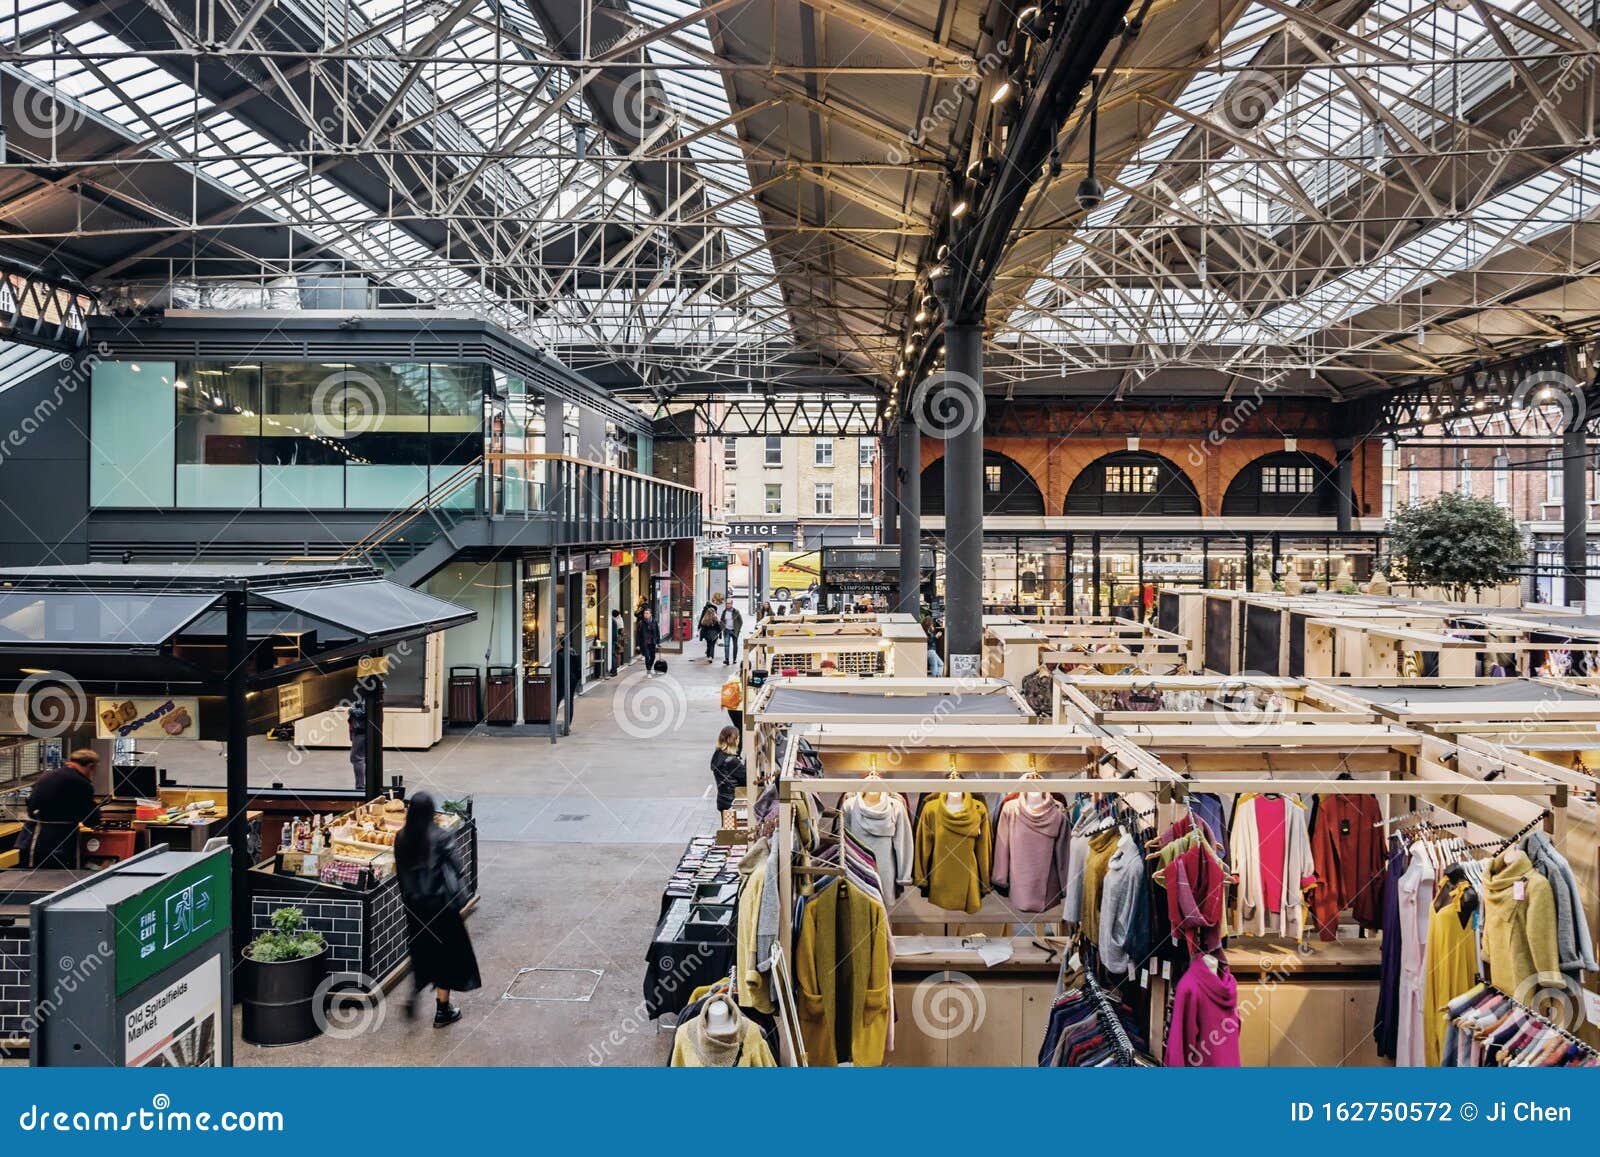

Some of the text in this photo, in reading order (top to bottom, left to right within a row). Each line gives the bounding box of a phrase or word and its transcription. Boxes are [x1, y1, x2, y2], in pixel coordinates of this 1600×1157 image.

[724, 525, 777, 535] OFFICE
[140, 911, 156, 927] FIRE
[140, 924, 156, 941] EXIT
[127, 983, 188, 1029] Old Spitalfields
[128, 1016, 158, 1043] Market
